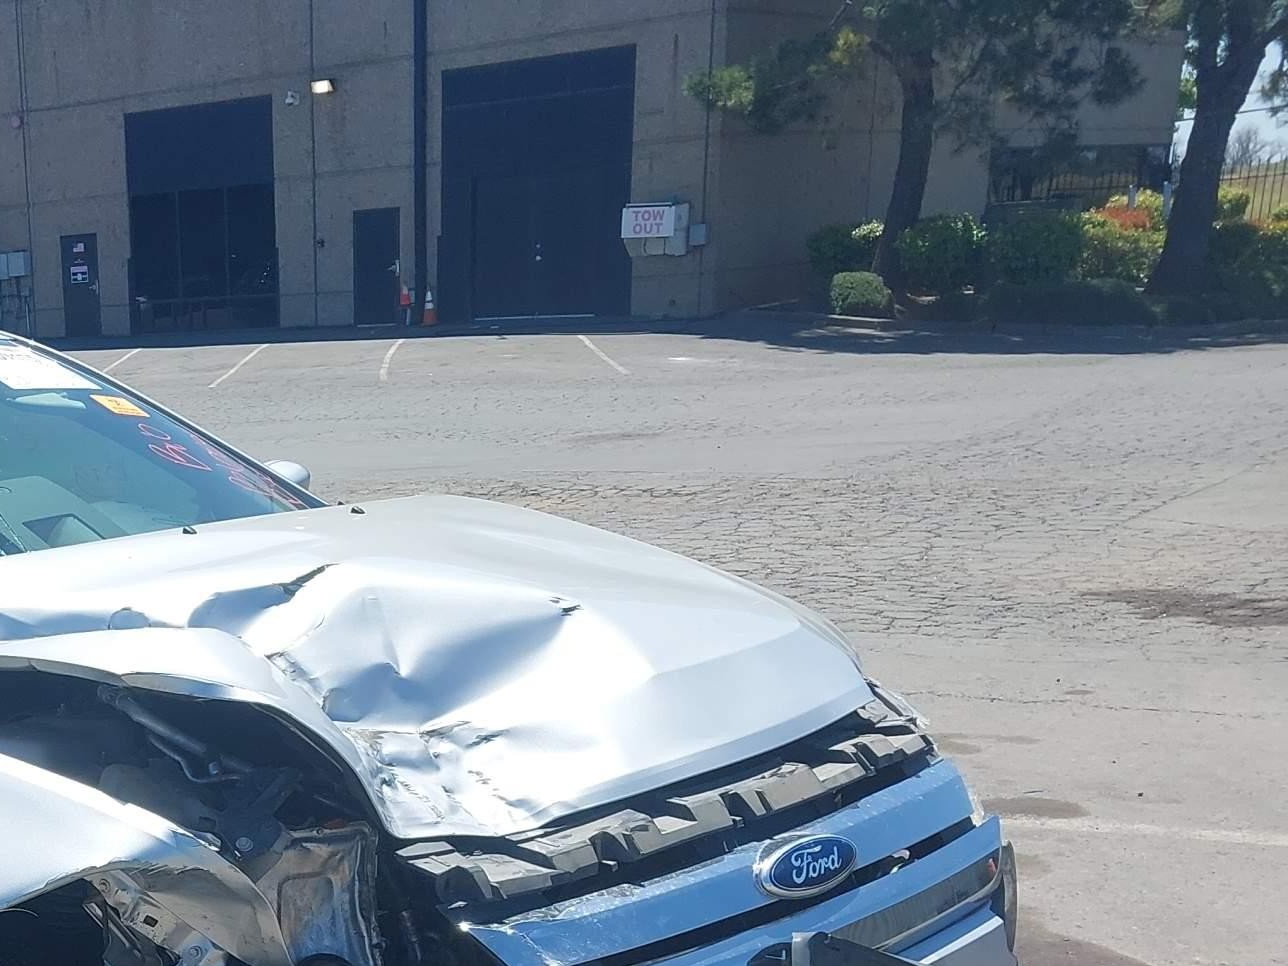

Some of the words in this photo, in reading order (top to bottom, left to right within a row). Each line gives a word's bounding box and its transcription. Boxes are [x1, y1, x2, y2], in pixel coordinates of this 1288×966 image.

[632, 210, 665, 221] TOW
[633, 223, 663, 234] OUT
[791, 845, 842, 884] Ford
